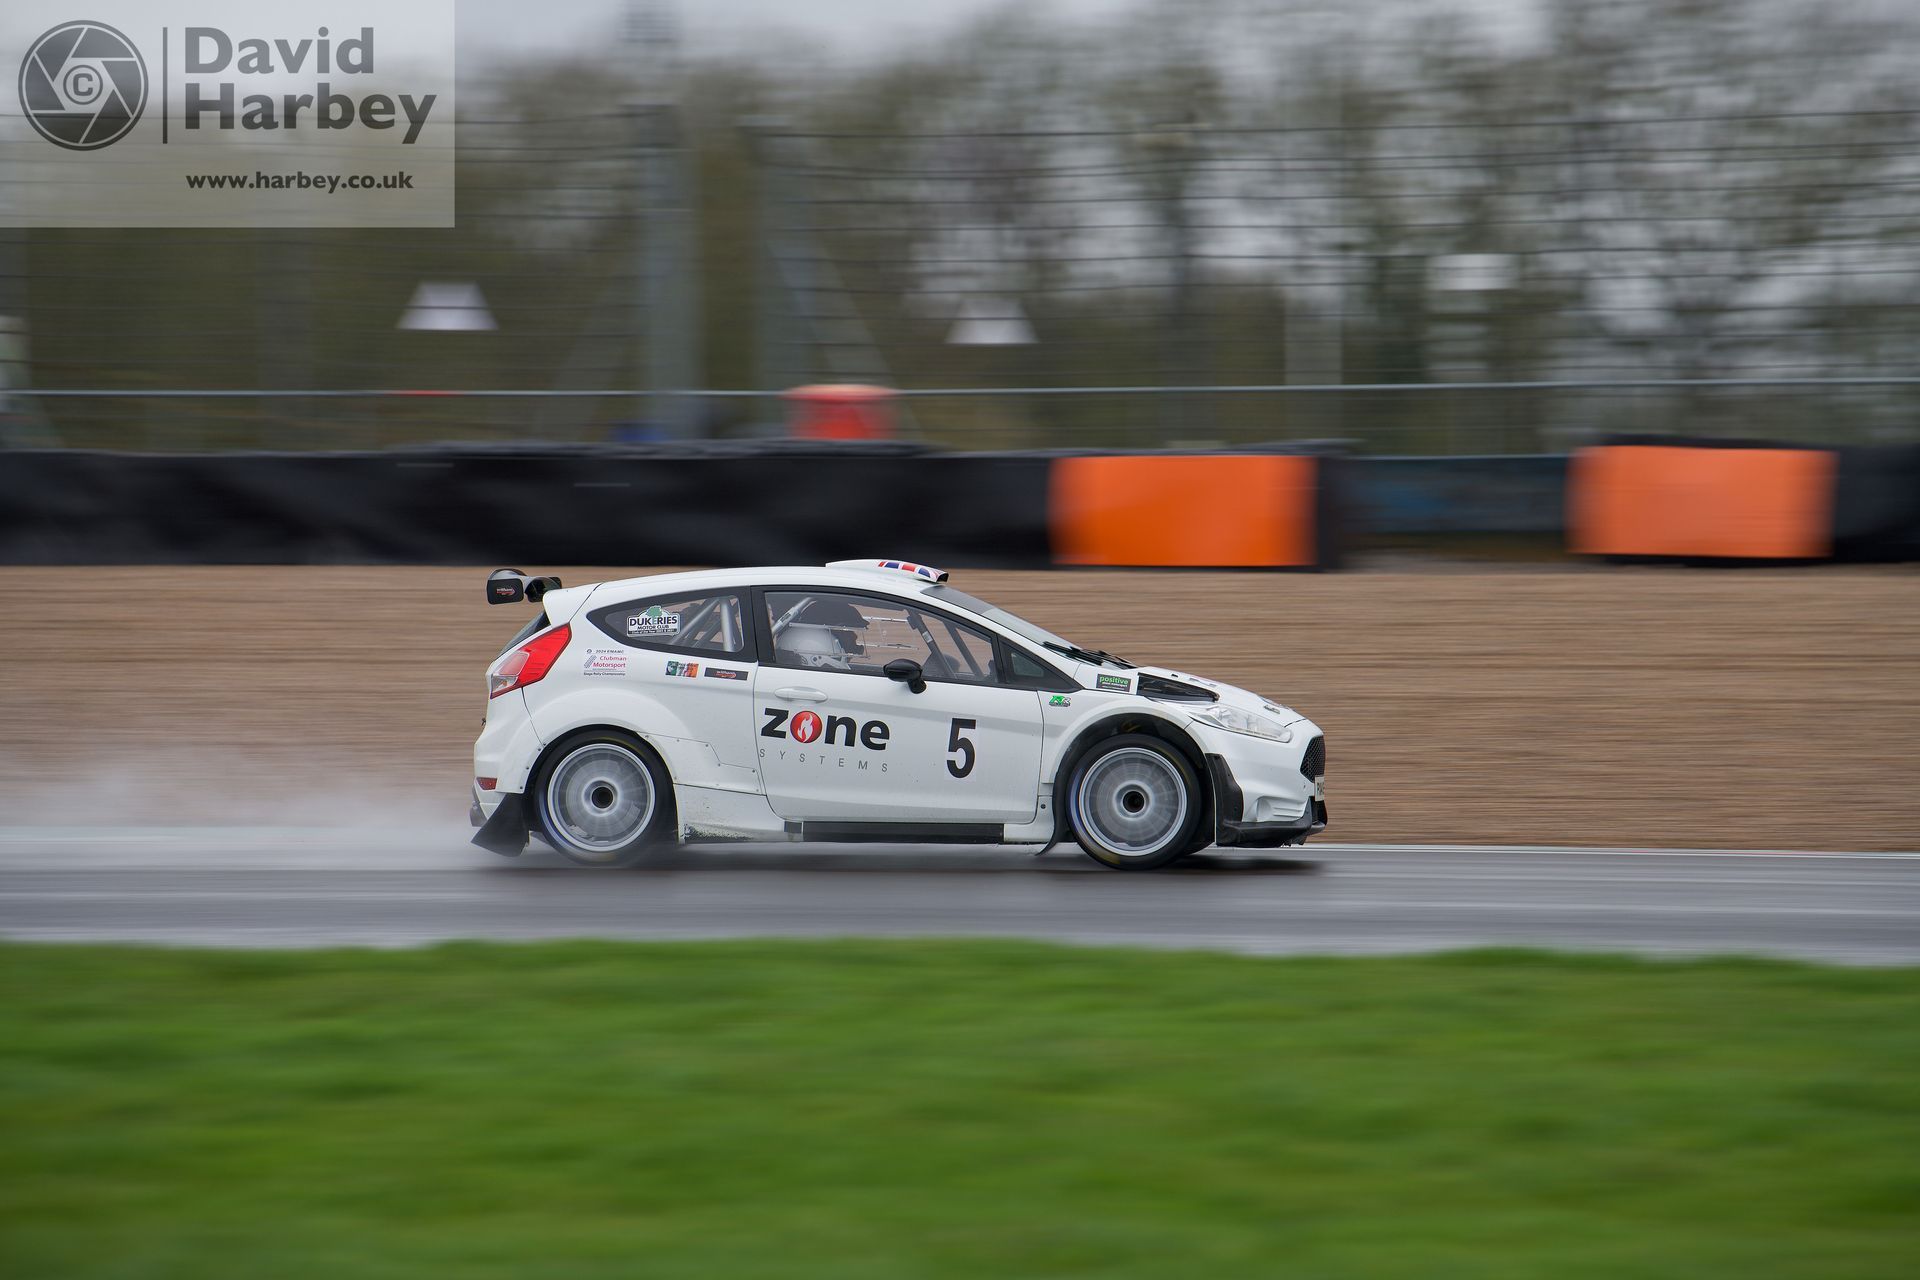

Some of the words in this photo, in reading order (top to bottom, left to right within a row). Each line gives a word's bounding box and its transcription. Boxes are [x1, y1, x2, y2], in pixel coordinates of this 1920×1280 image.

[630, 616, 677, 626] DUKERIES
[1099, 675, 1129, 685] positive
[761, 708, 890, 751] zone
[946, 717, 977, 779] 5
[759, 749, 888, 773] SYSTEMS
